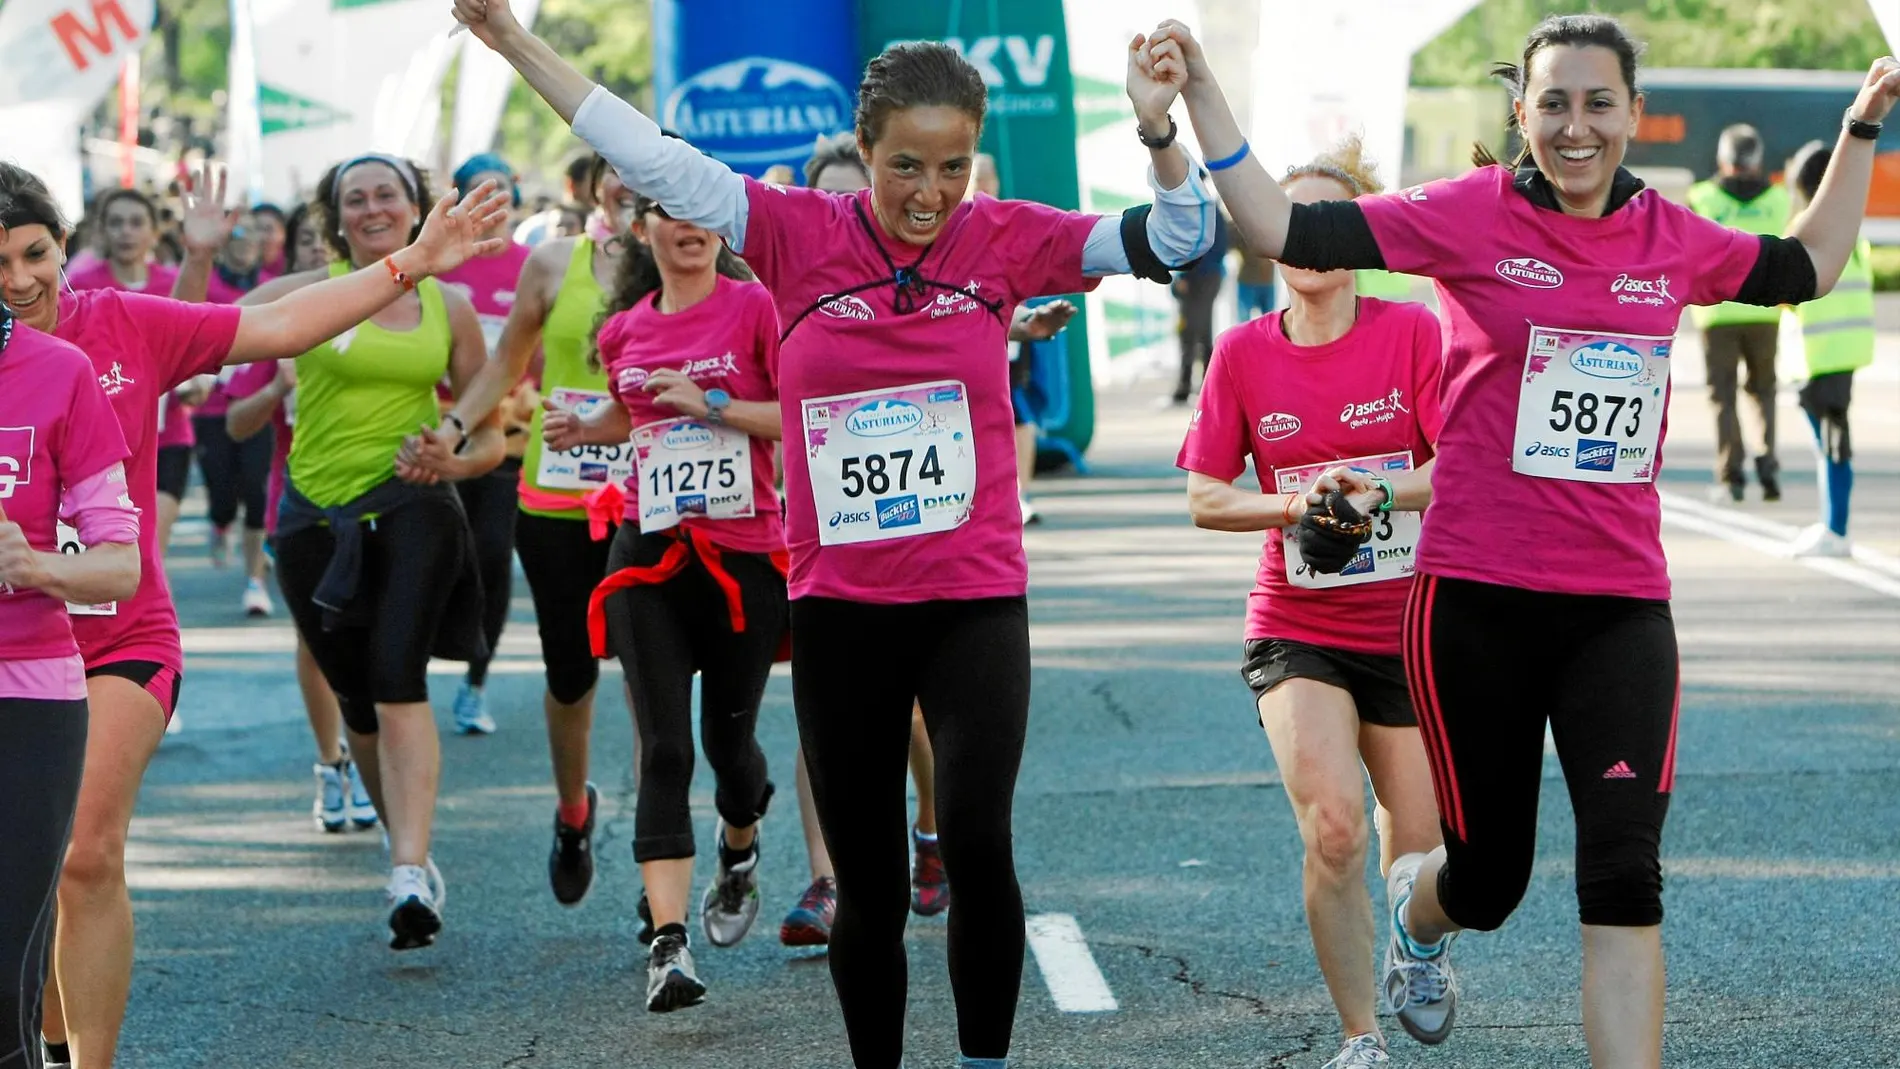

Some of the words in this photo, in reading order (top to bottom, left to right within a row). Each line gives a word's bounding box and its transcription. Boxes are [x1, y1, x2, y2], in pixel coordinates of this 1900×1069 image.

[51, 0, 139, 70] M
[1501, 262, 1558, 284] ASTURIANA
[822, 300, 869, 320] TURIANA
[1575, 351, 1639, 372] ASTURIANA
[853, 413, 917, 431] ASTURIANA
[1549, 390, 1643, 438] 5873
[1620, 447, 1647, 459] DKV
[650, 458, 736, 497] 11275
[841, 444, 945, 499] 5874
[710, 493, 743, 505] DKV
[923, 492, 966, 509] DKV
[1377, 546, 1412, 560] DKV
